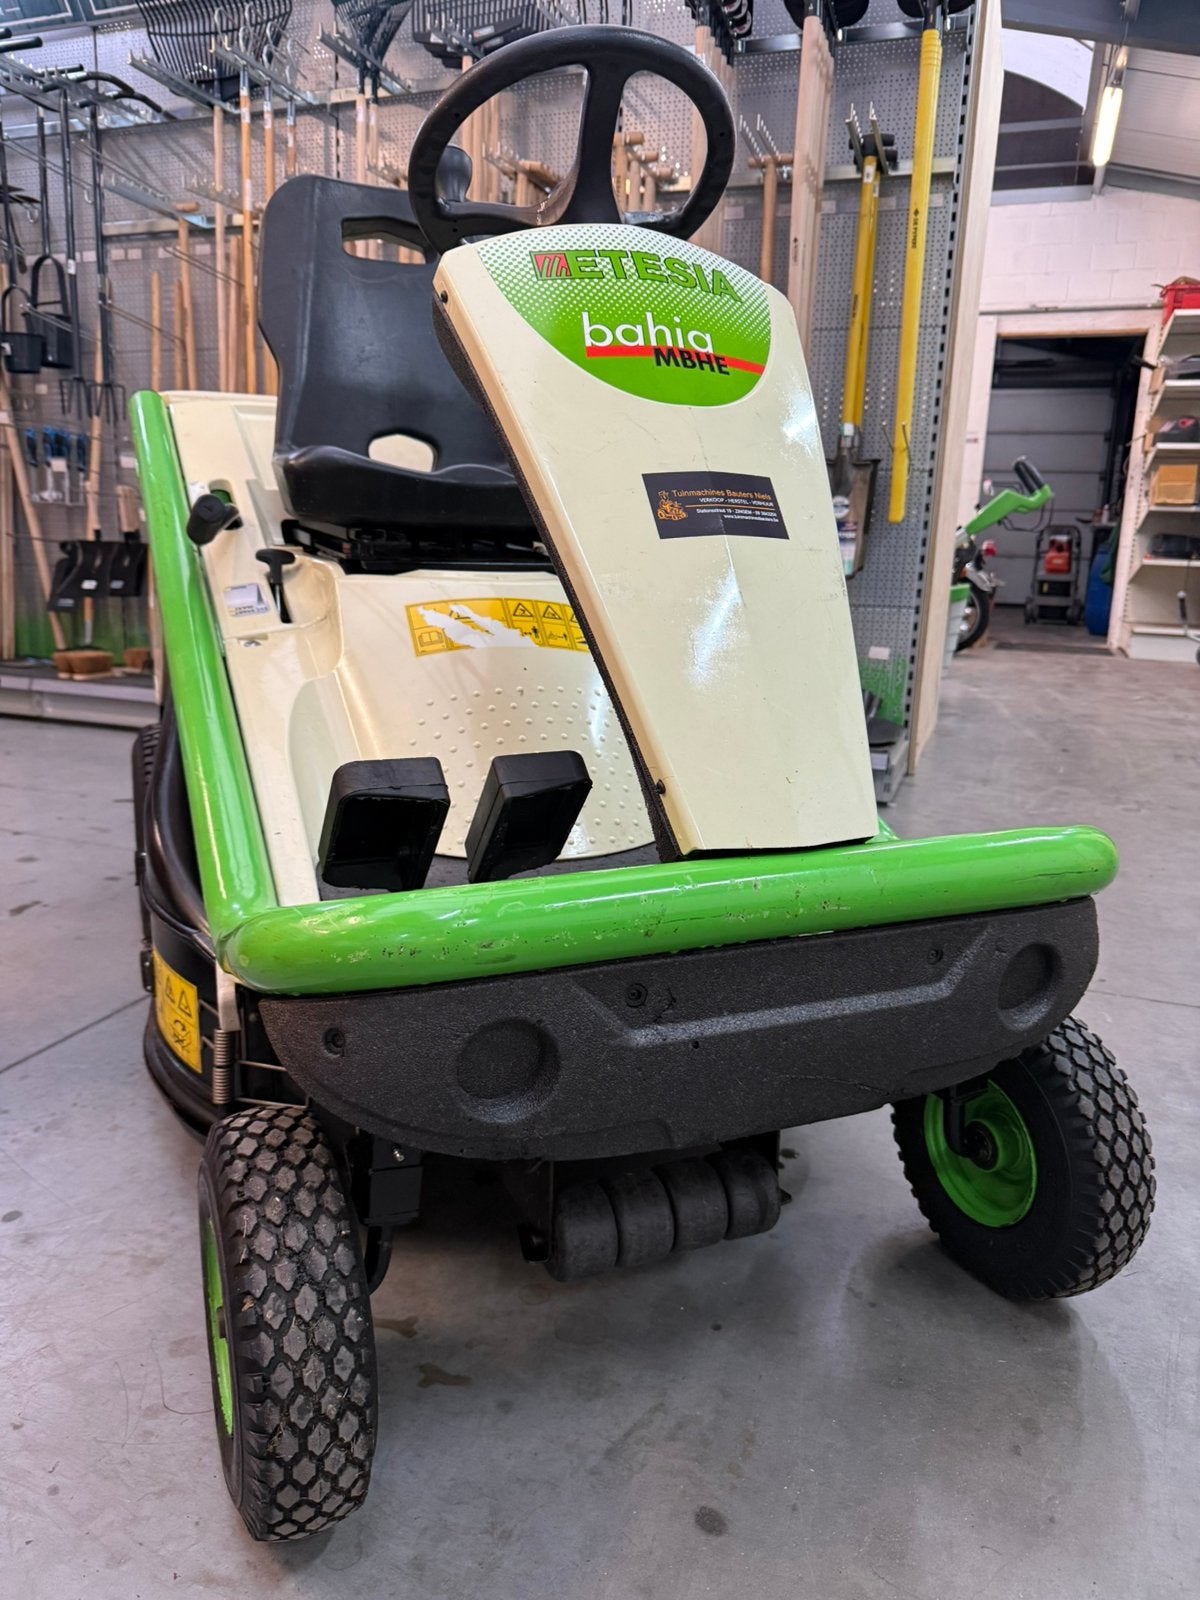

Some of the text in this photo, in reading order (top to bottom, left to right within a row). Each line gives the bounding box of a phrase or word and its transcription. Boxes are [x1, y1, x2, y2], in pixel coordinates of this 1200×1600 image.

[564, 250, 743, 303] ETESIA
[582, 311, 714, 354] bahia
[653, 347, 730, 376] MBHE
[672, 488, 772, 501] Tuinmachines Bauters Niels
